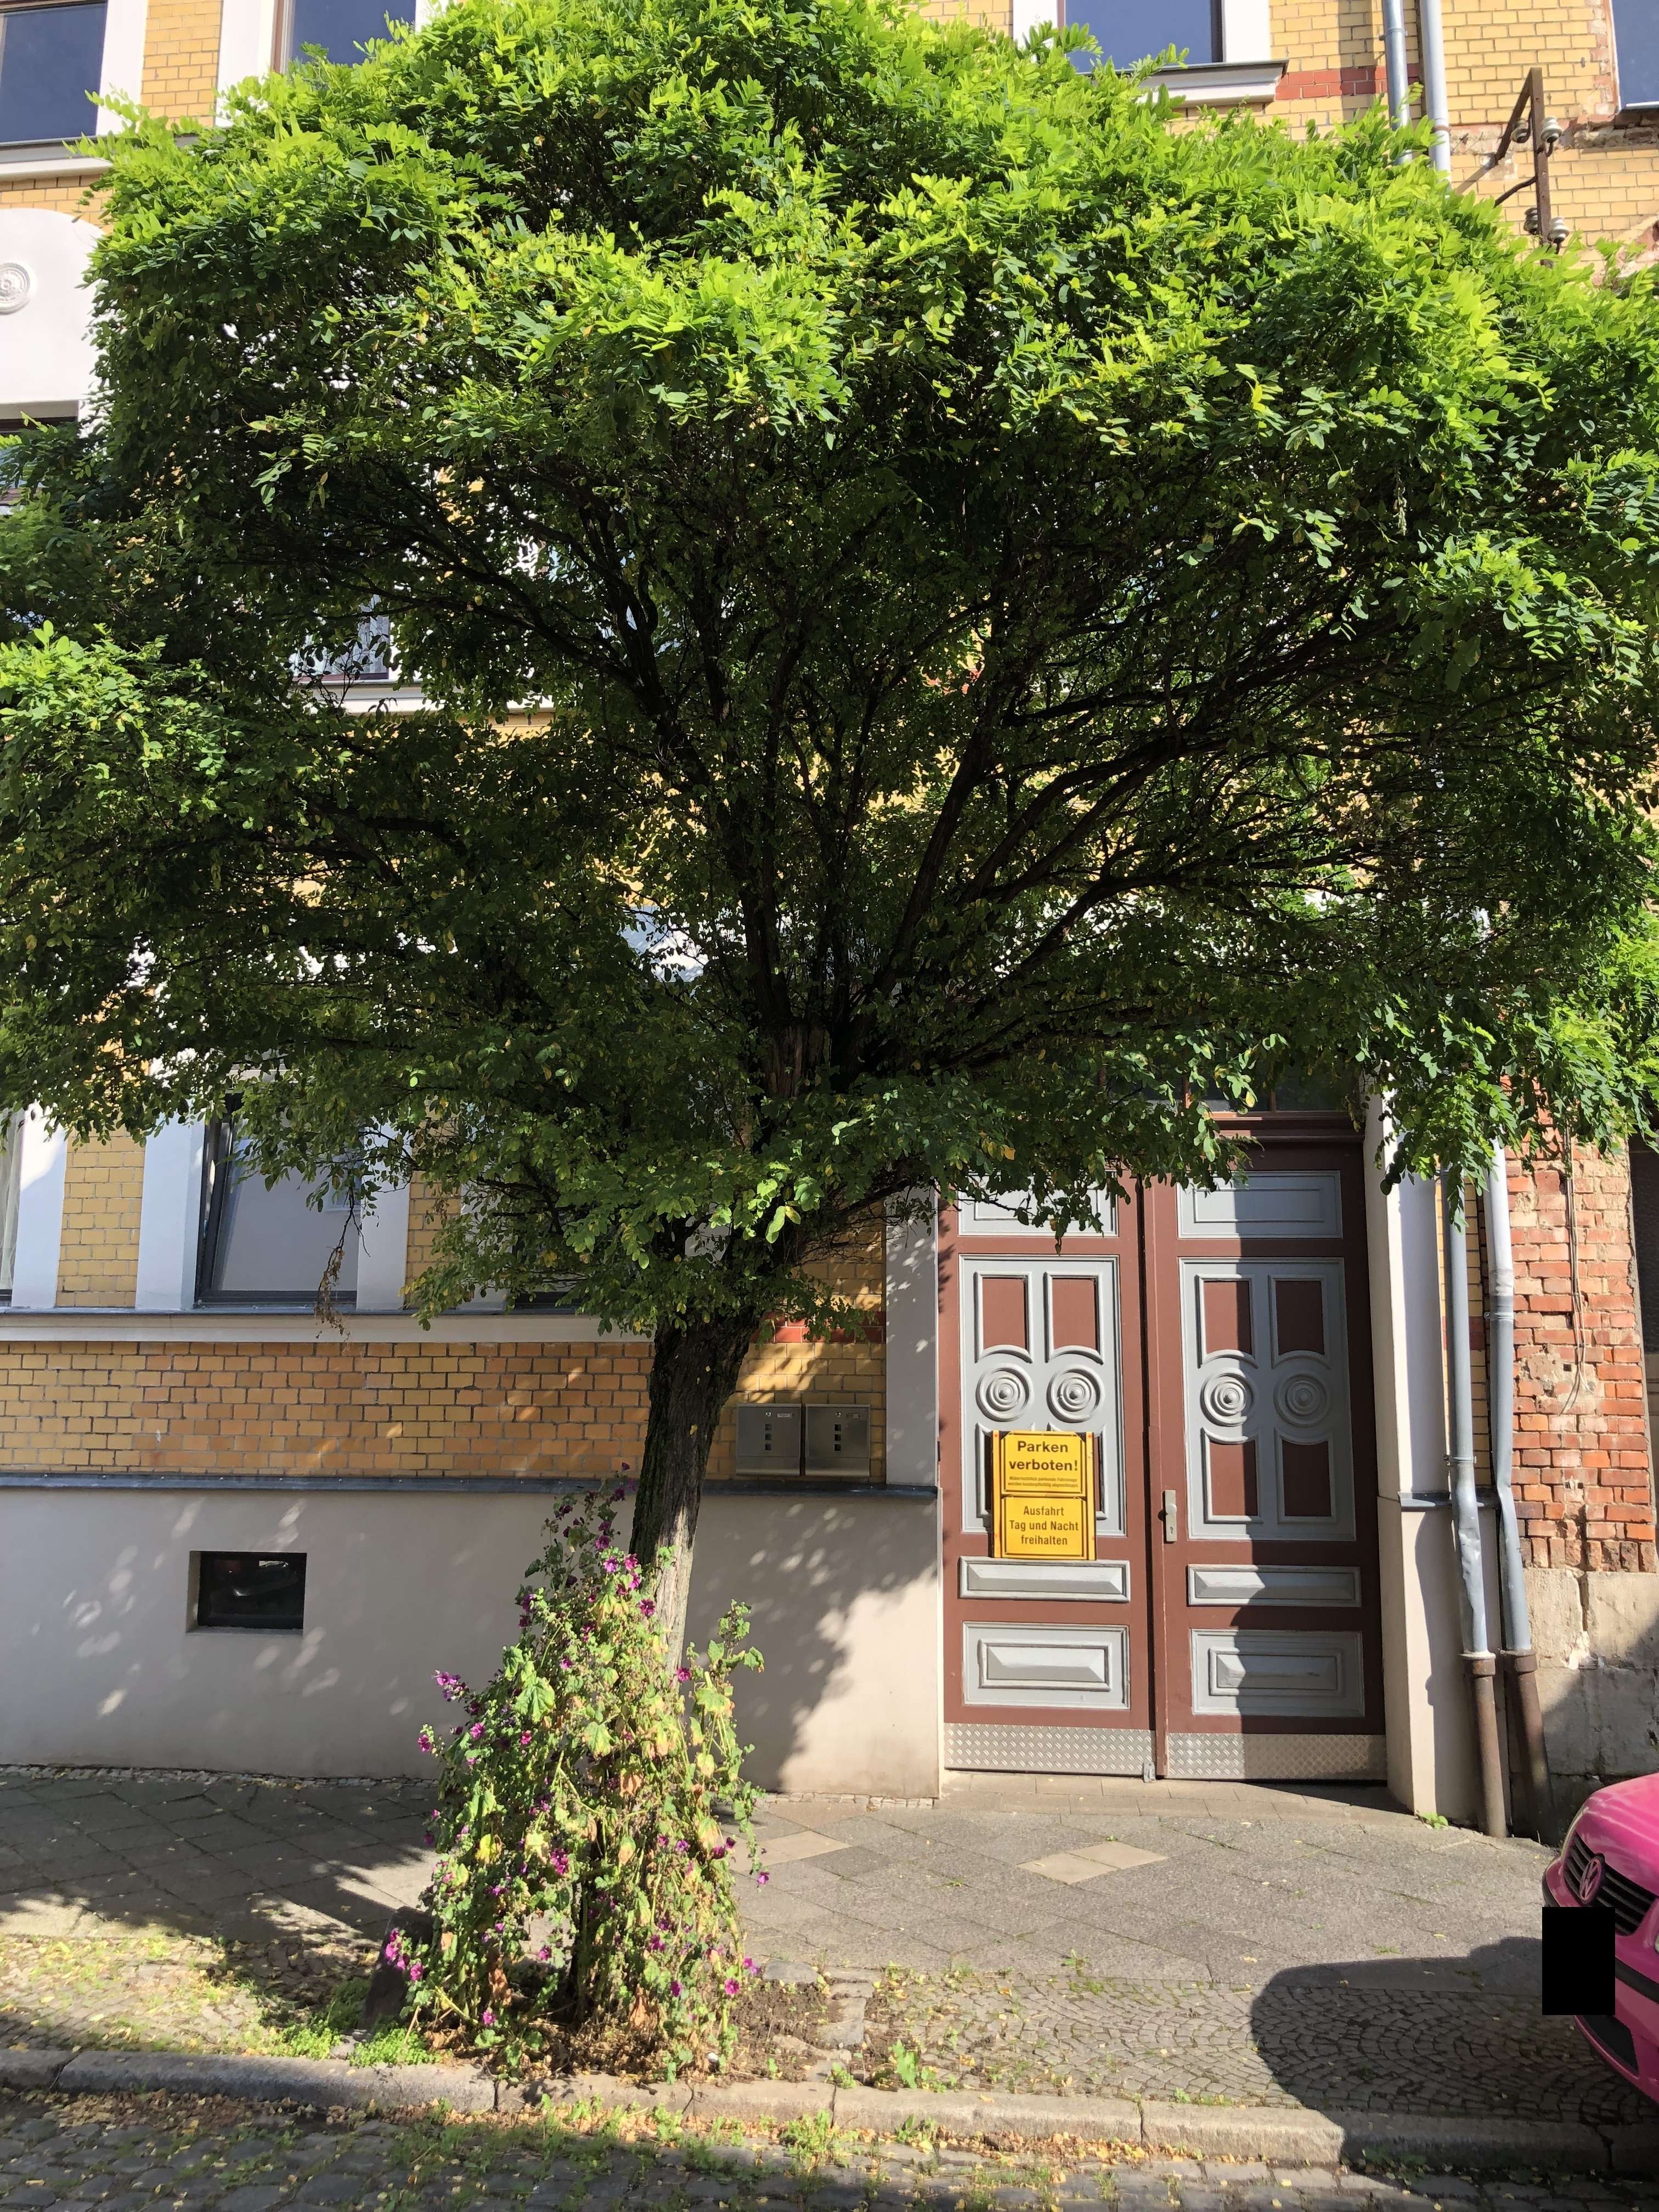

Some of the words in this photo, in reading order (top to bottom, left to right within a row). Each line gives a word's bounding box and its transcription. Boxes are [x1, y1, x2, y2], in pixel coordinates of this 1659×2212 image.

[1018, 1441, 1068, 1452] Parken
[1009, 1459, 1077, 1471] verboten!
[1023, 1506, 1064, 1516] Ausfahrt
[1009, 1520, 1026, 1531] Tag
[1029, 1521, 1047, 1531] und
[1051, 1521, 1079, 1531] Nacht
[1021, 1535, 1068, 1545] freihalten
